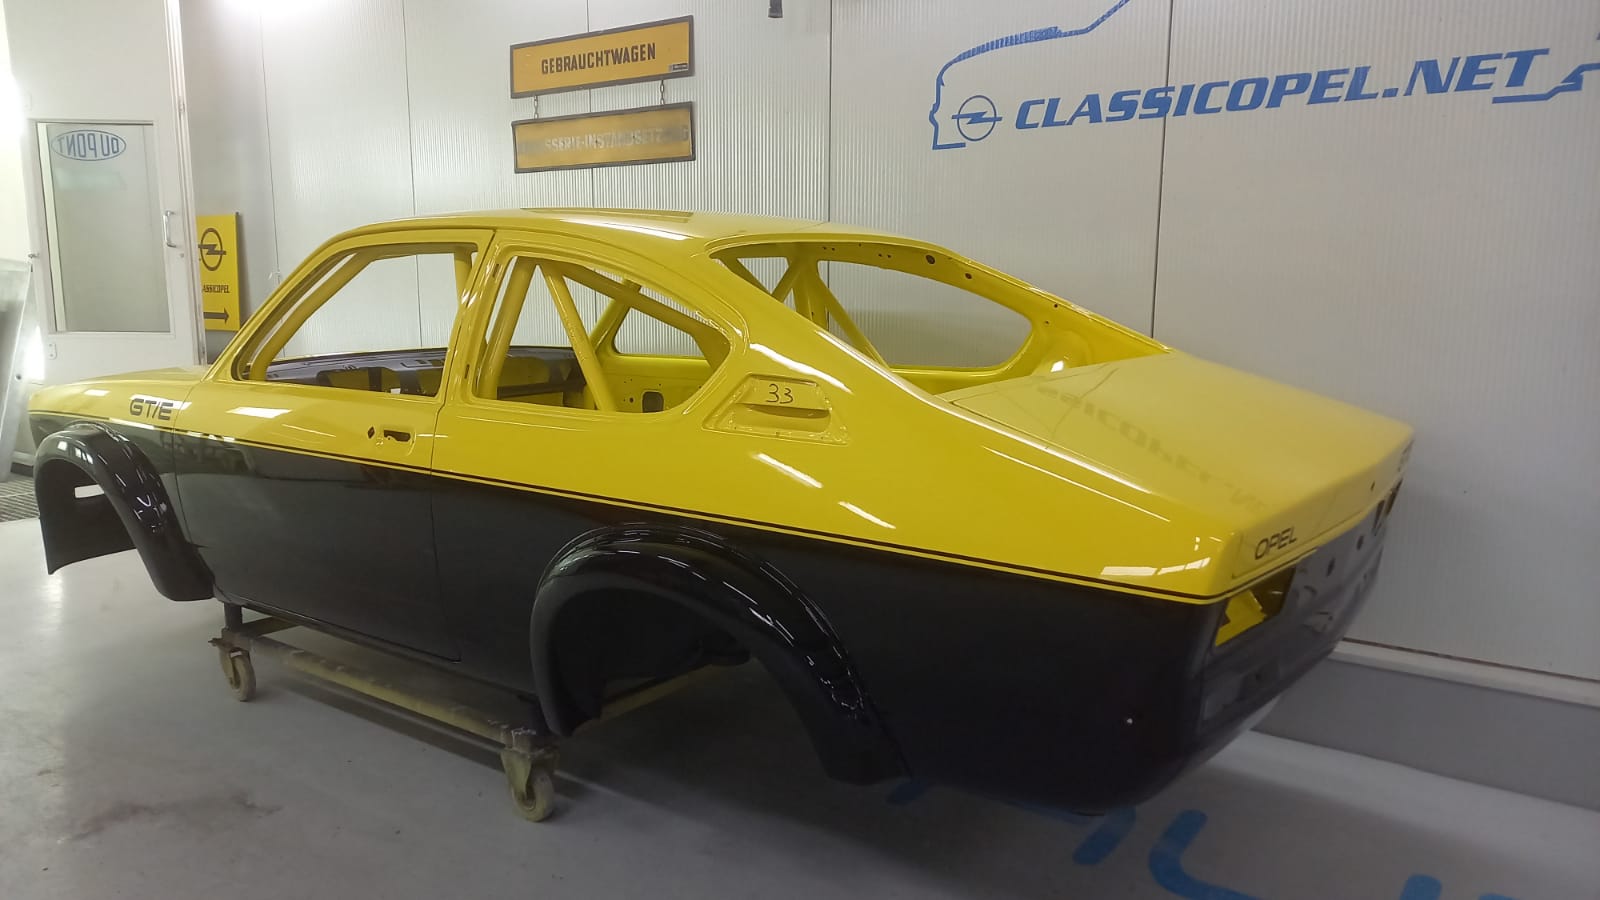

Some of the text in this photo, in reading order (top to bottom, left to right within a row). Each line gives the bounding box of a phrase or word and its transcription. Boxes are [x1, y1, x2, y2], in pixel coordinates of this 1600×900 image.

[541, 43, 656, 74] GEBRAUCHTWAGEN
[1015, 48, 1550, 130] CLASSICOPEL.NET
[130, 398, 173, 420] GT/E
[766, 383, 794, 404] 33
[1254, 527, 1298, 560] OPEL
